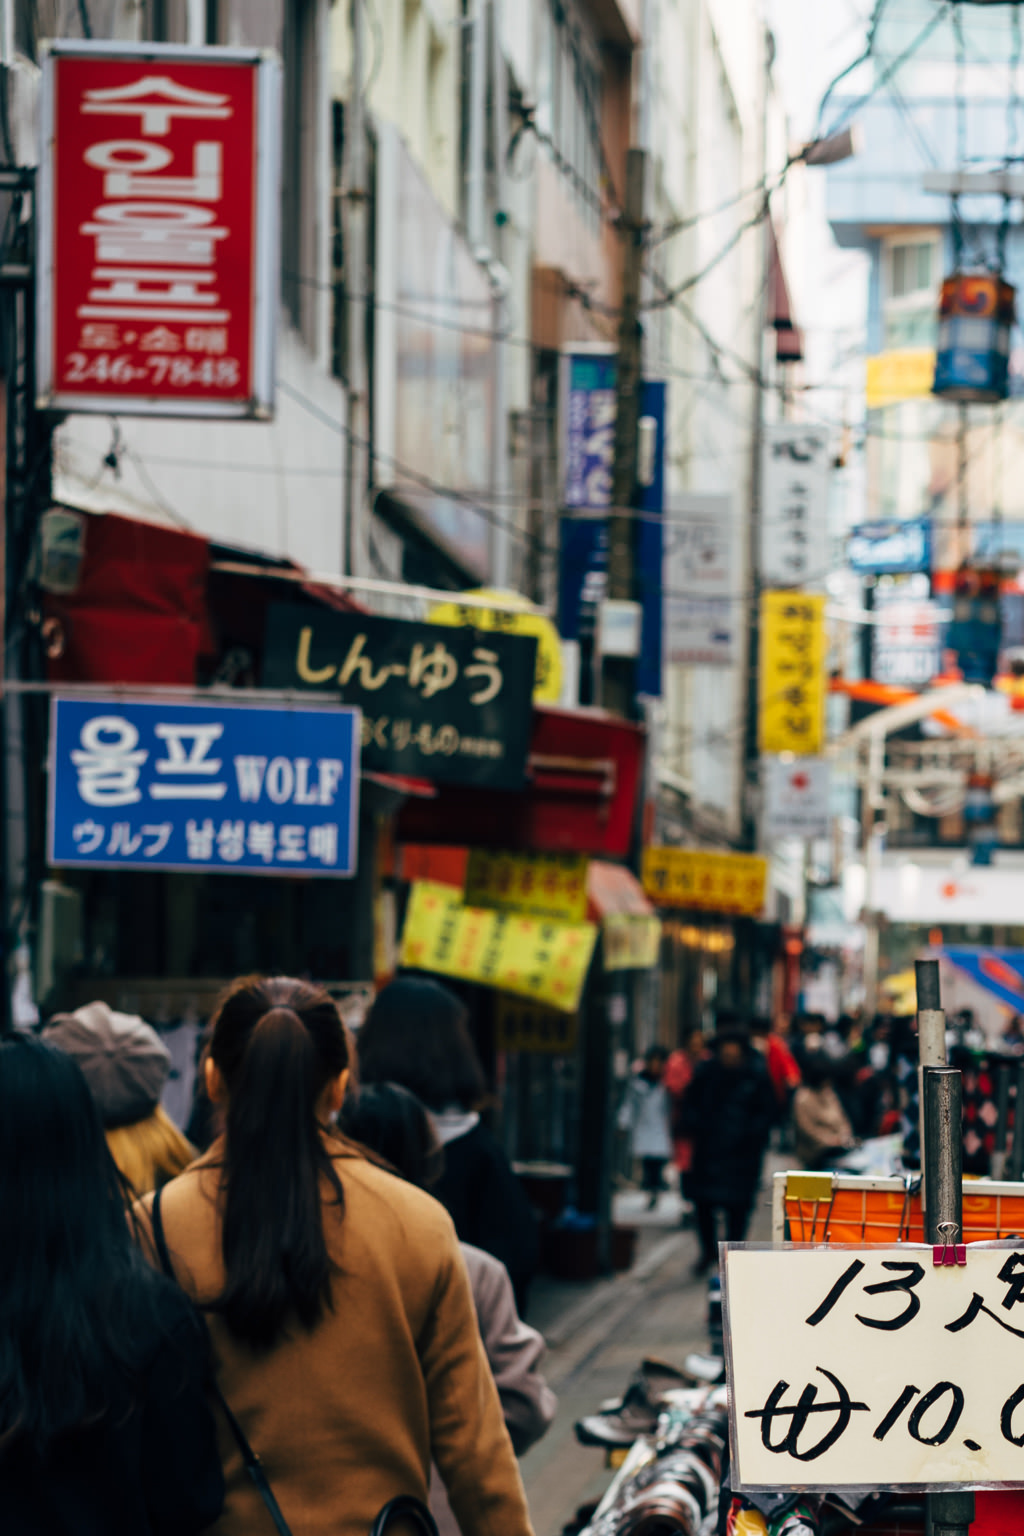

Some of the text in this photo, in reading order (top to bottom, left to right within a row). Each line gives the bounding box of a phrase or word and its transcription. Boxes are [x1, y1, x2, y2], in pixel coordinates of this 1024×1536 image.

[71, 714, 344, 807] 울프 WOLF
[72, 818, 174, 858] ウルフ
